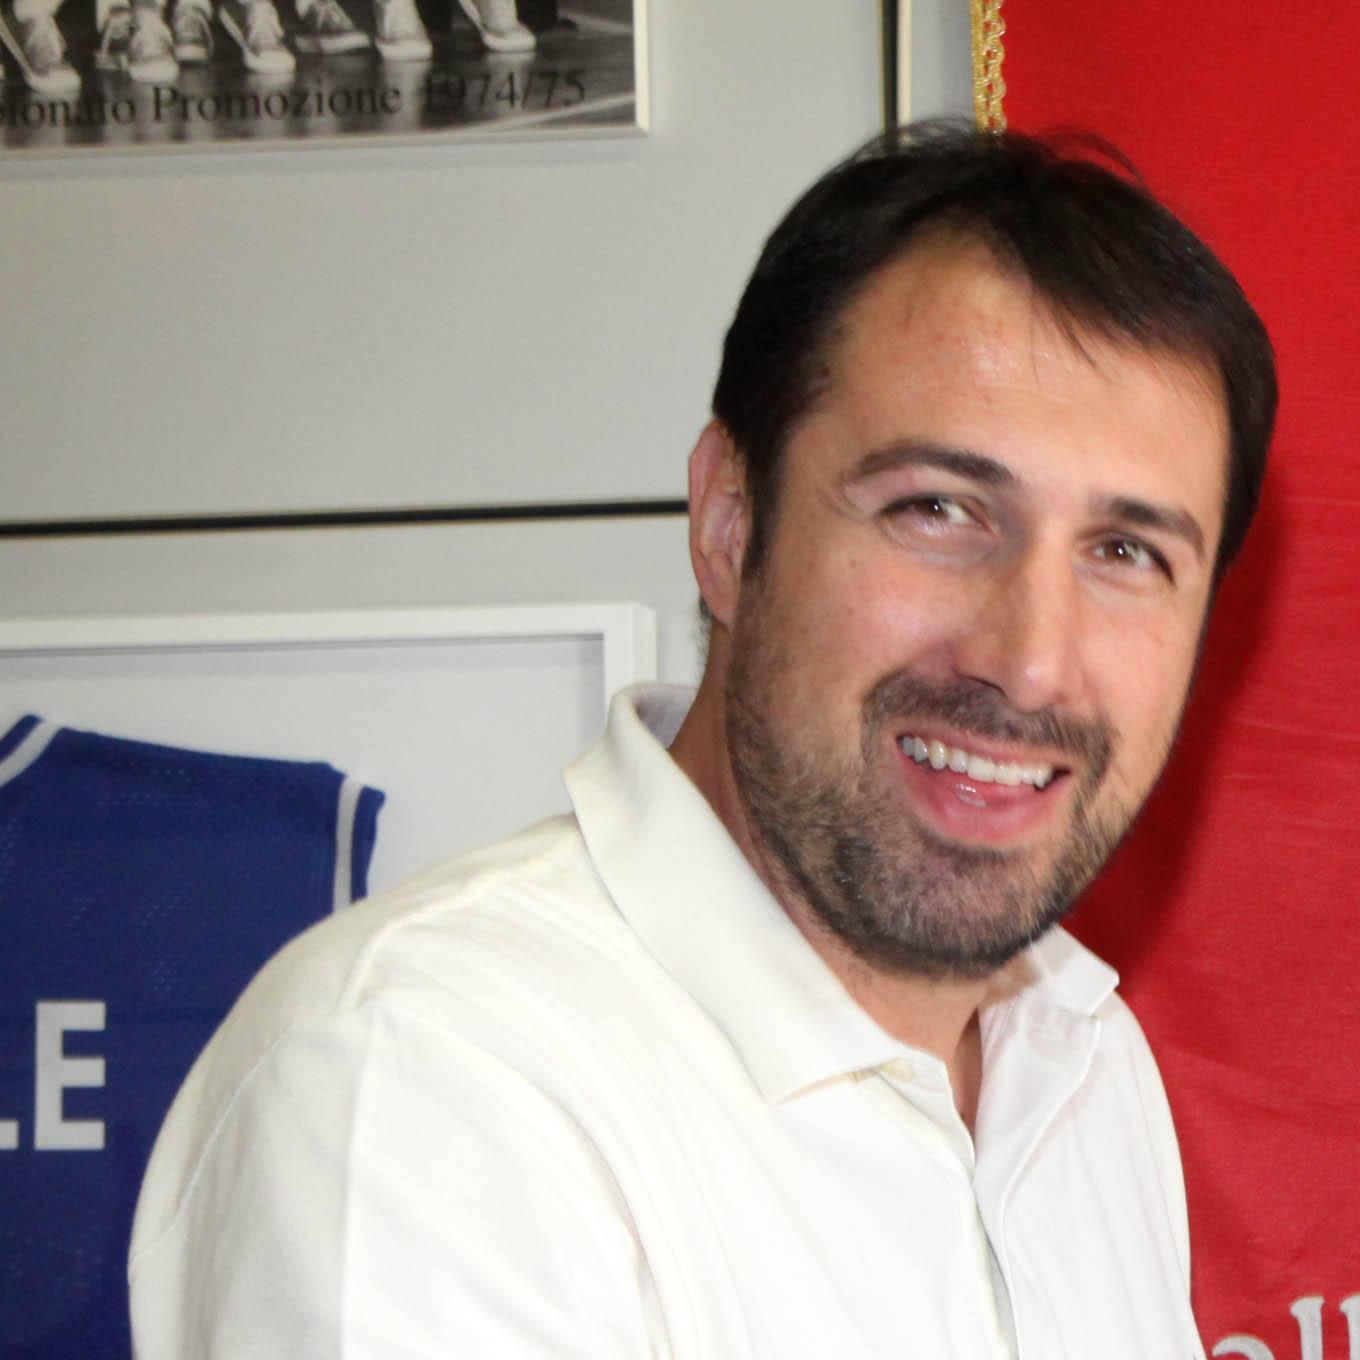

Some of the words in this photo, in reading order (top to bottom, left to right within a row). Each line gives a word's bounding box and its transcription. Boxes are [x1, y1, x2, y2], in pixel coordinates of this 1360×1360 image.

[152, 76, 403, 123] Promozione
[423, 70, 585, 114] 1974/75
[0, 1000, 106, 1151] E
